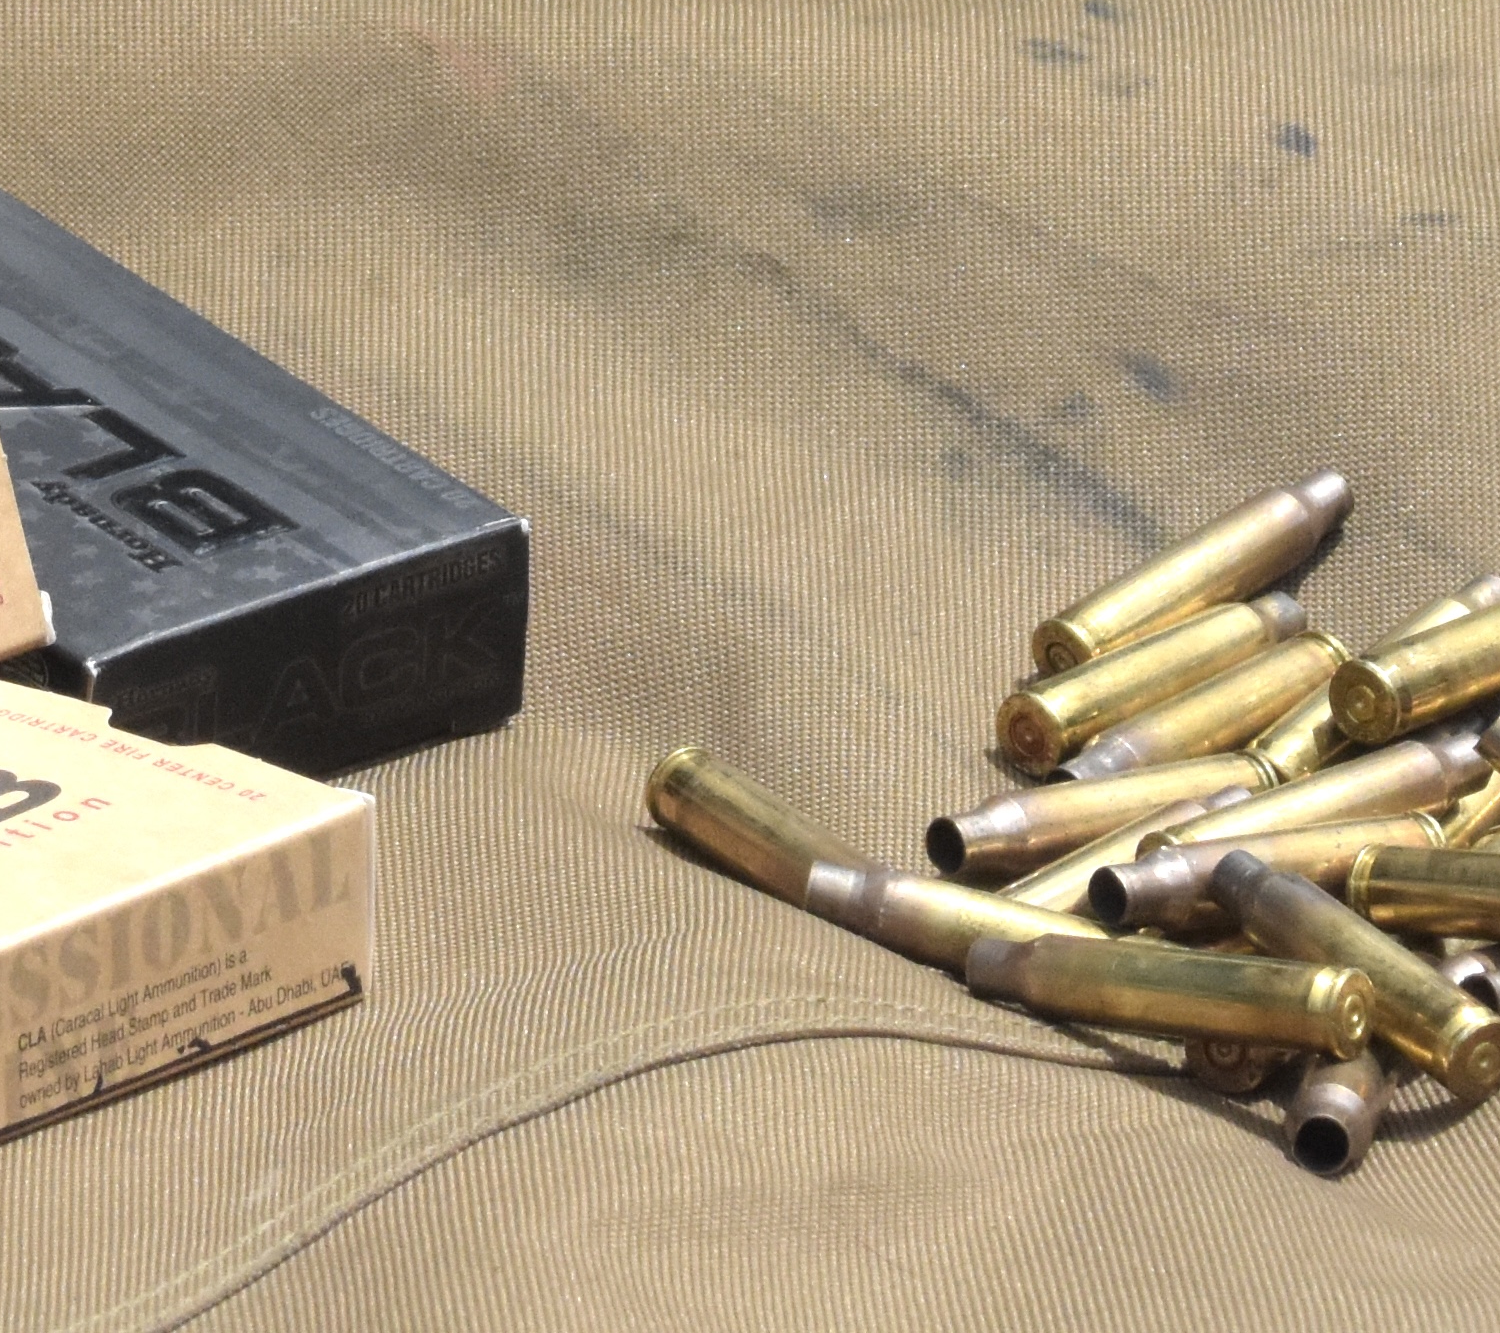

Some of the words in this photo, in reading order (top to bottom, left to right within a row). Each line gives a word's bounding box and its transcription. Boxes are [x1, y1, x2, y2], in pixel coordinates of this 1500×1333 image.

[98, 738, 152, 761] FIRE
[151, 756, 236, 792] CENTER
[237, 787, 267, 803] 20
[17, 1025, 48, 1053] CLA
[49, 1005, 107, 1042] (Caracal
[106, 991, 140, 1019] Light
[141, 958, 223, 1004] Ammunition)
[224, 953, 237, 970] is
[238, 951, 248, 965] a
[18, 1038, 89, 1082] Registered
[89, 1024, 126, 1051] Head
[127, 1010, 170, 1042] Stamp
[171, 997, 199, 1019] and
[199, 984, 238, 1011] Trade
[239, 967, 274, 992] Mark
[18, 1083, 62, 1110] owned
[63, 1073, 81, 1093] by
[83, 1055, 124, 1084] Lahab
[126, 1039, 159, 1069] Light
[160, 1011, 237, 1053] Ammunition
[247, 996, 274, 1020] Abu
